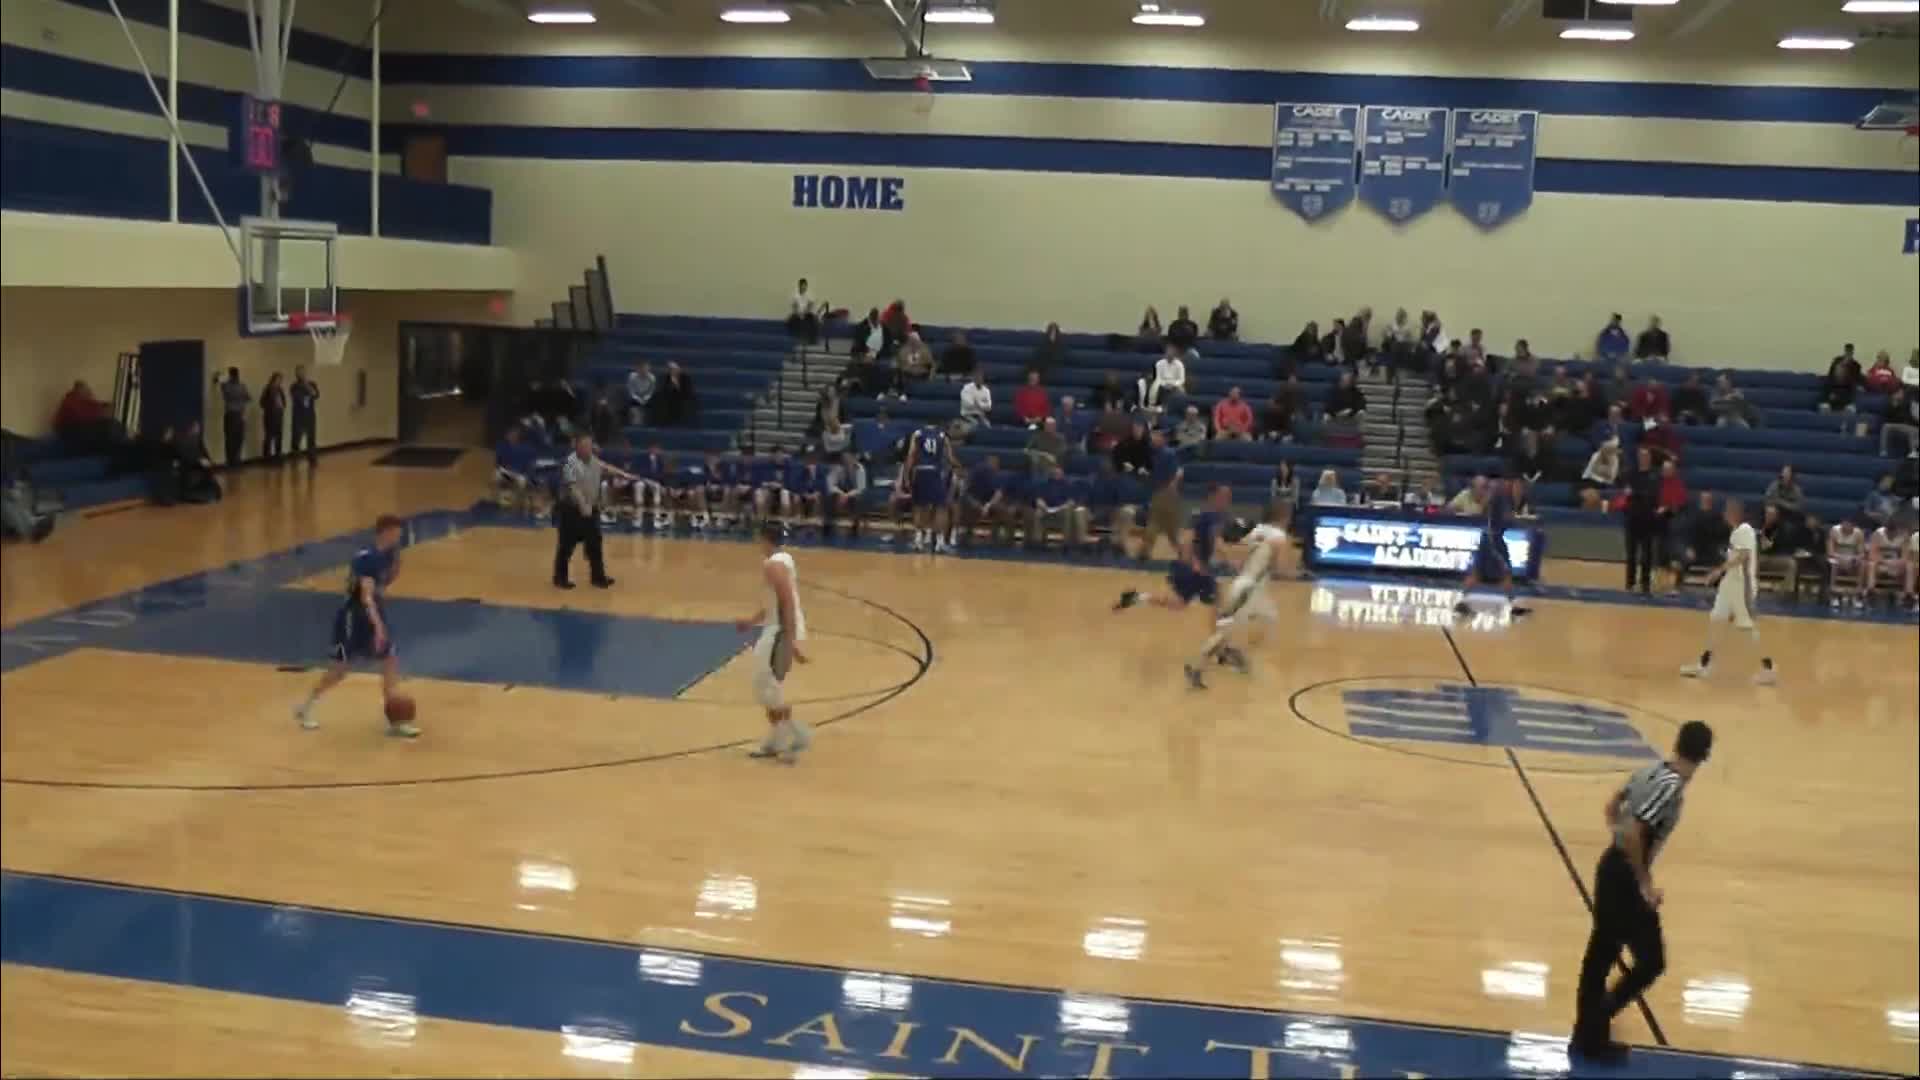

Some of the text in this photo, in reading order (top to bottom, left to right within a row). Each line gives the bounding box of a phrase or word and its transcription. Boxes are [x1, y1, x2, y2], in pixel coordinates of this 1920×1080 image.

[1293, 107, 1343, 118] CADET
[1381, 109, 1432, 121] CADET
[1470, 112, 1521, 124] CADET
[793, 175, 904, 210] HOME
[679, 991, 1151, 1079] SAINT
